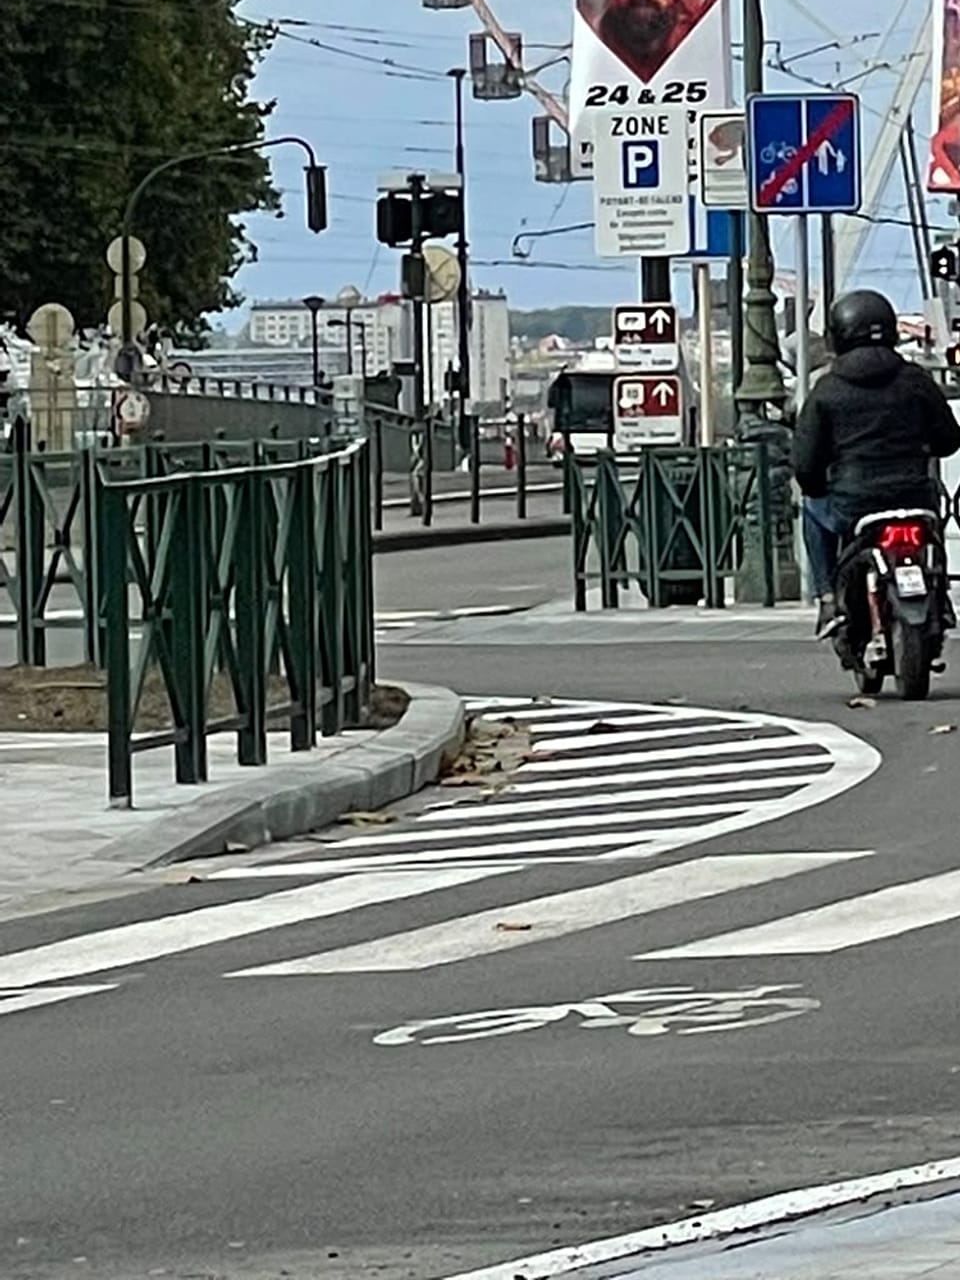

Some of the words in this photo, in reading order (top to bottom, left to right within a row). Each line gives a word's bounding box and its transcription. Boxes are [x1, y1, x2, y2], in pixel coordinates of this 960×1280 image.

[585, 85, 630, 107] 24
[637, 88, 656, 105] &
[662, 81, 708, 104] 25
[611, 115, 670, 137] ZONE
[627, 145, 654, 185] P
